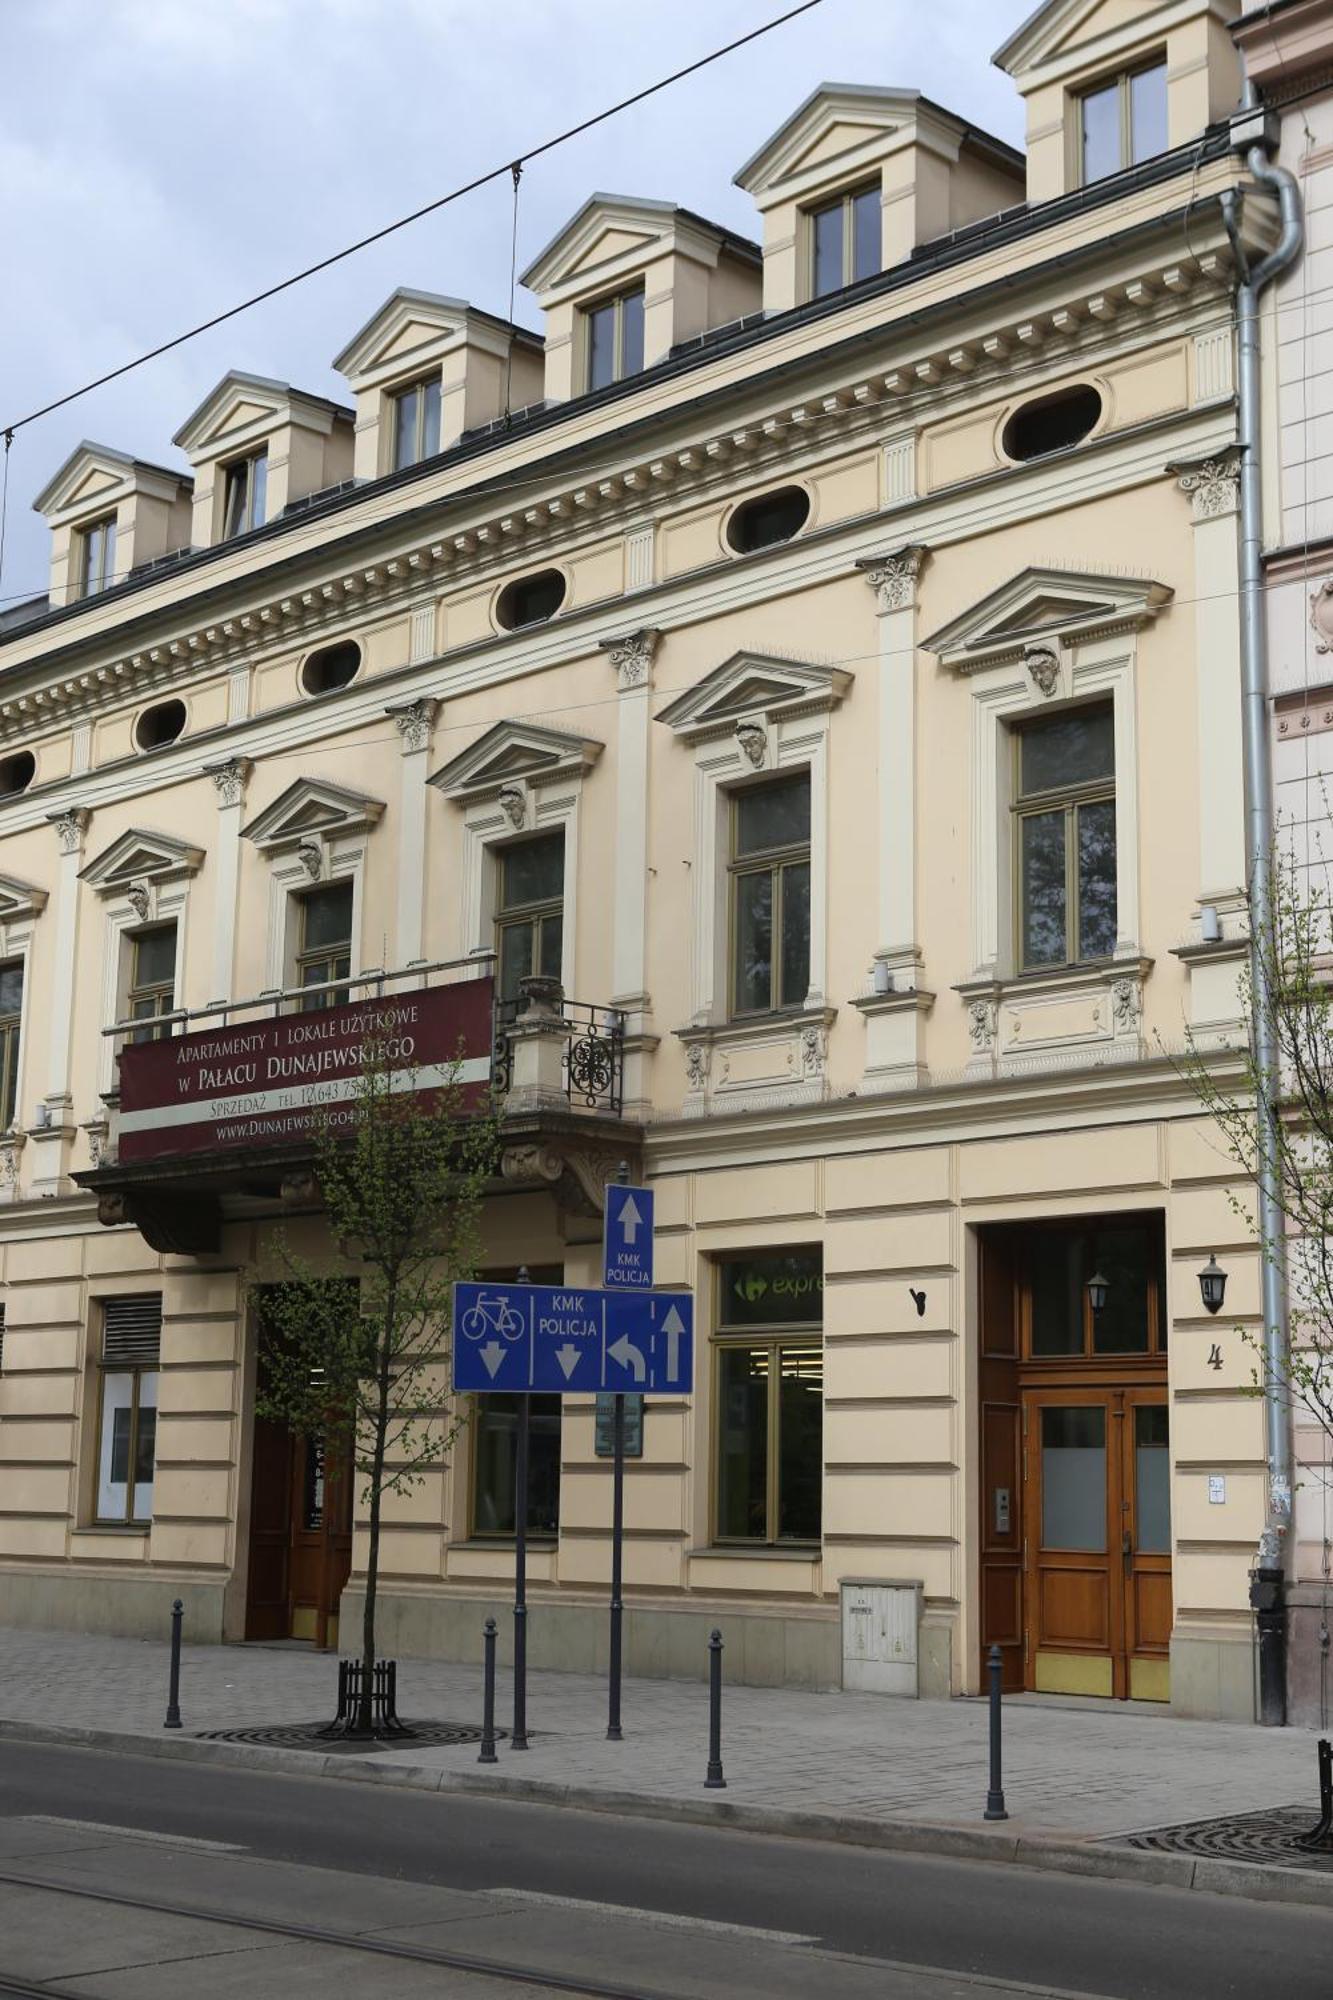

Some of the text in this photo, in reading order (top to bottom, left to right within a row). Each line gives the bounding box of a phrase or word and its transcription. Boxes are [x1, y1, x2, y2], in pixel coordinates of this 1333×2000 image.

[177, 1033, 266, 1064] APARTAMENTY
[288, 1019, 336, 1045] LOKALE
[198, 1063, 257, 1090] PAŁACU
[210, 1093, 267, 1118] SPRZEDAŻ
[617, 1252, 641, 1267] KMK
[608, 1268, 650, 1284] POLICJA
[552, 1295, 585, 1313] KMK
[539, 1318, 598, 1337] POLICJA
[1207, 1344, 1225, 1370] 4
